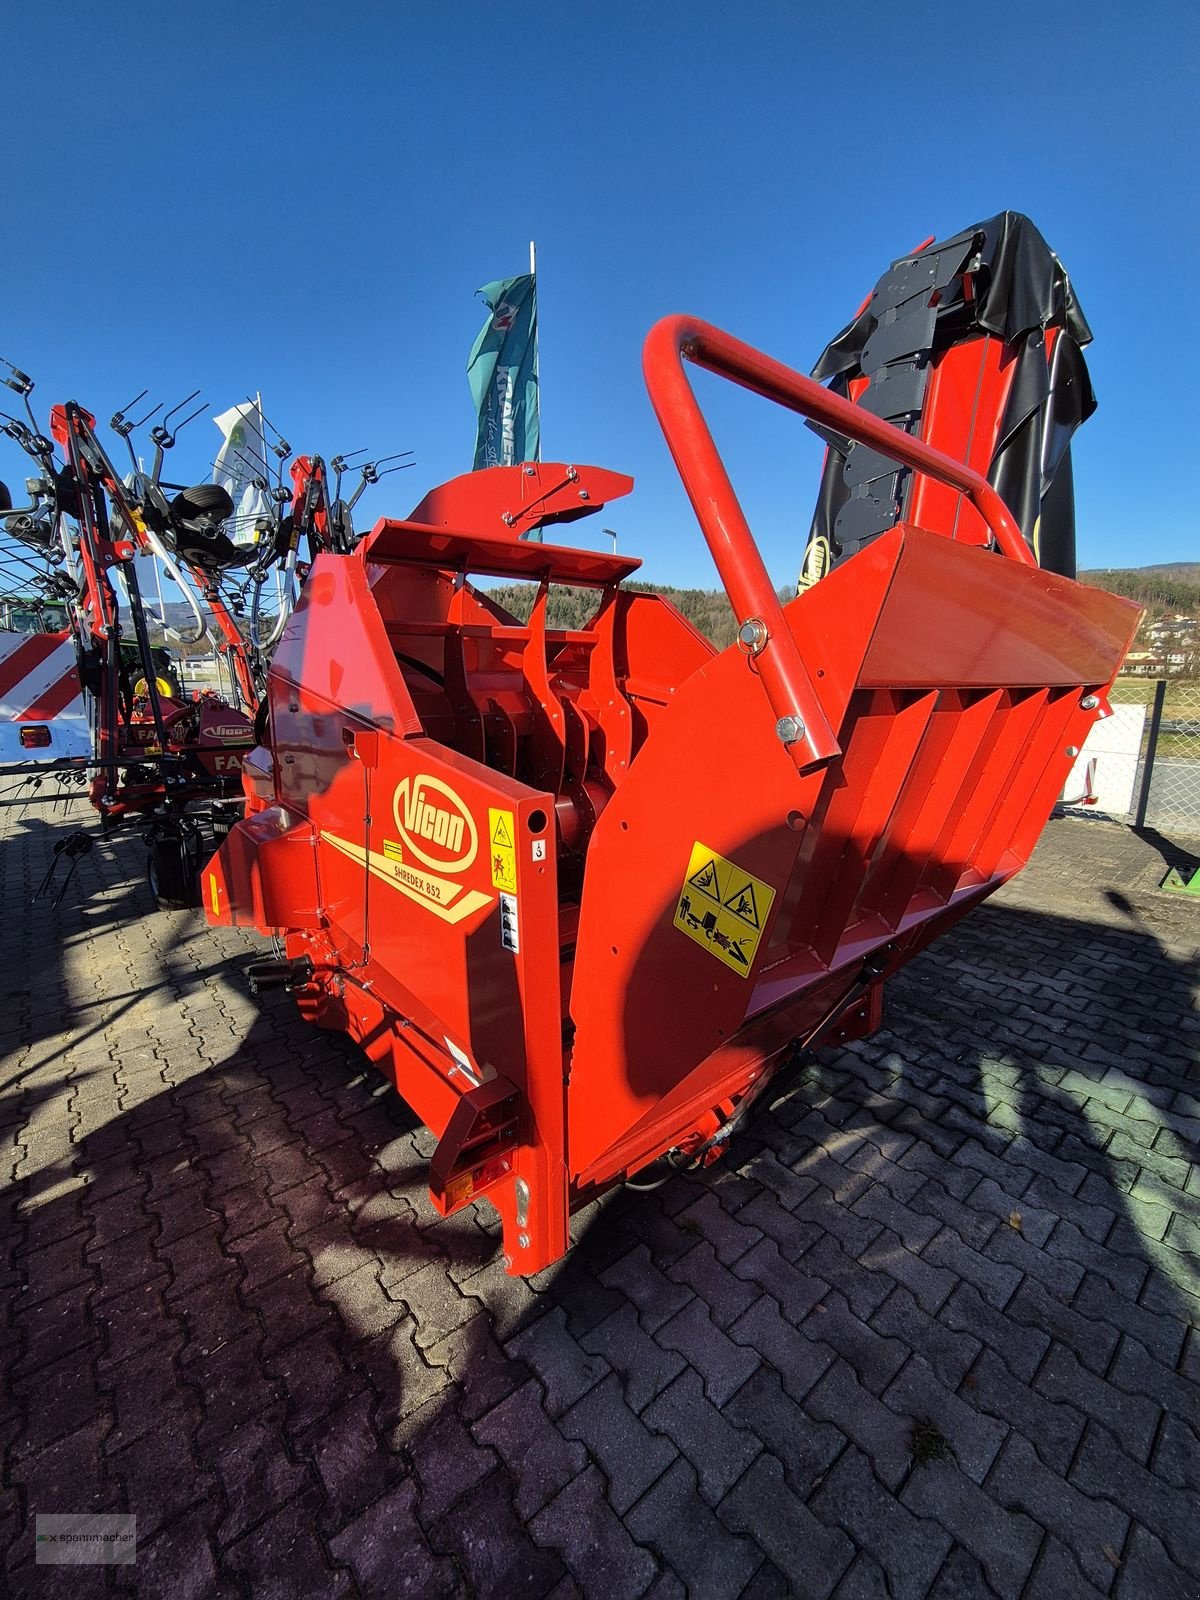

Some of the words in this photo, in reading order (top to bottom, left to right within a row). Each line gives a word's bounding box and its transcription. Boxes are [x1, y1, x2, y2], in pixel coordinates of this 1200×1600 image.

[203, 725, 252, 737] Vicon
[393, 774, 466, 854] Vicon
[394, 865, 425, 891] SHREDEX
[426, 882, 441, 899] 852
